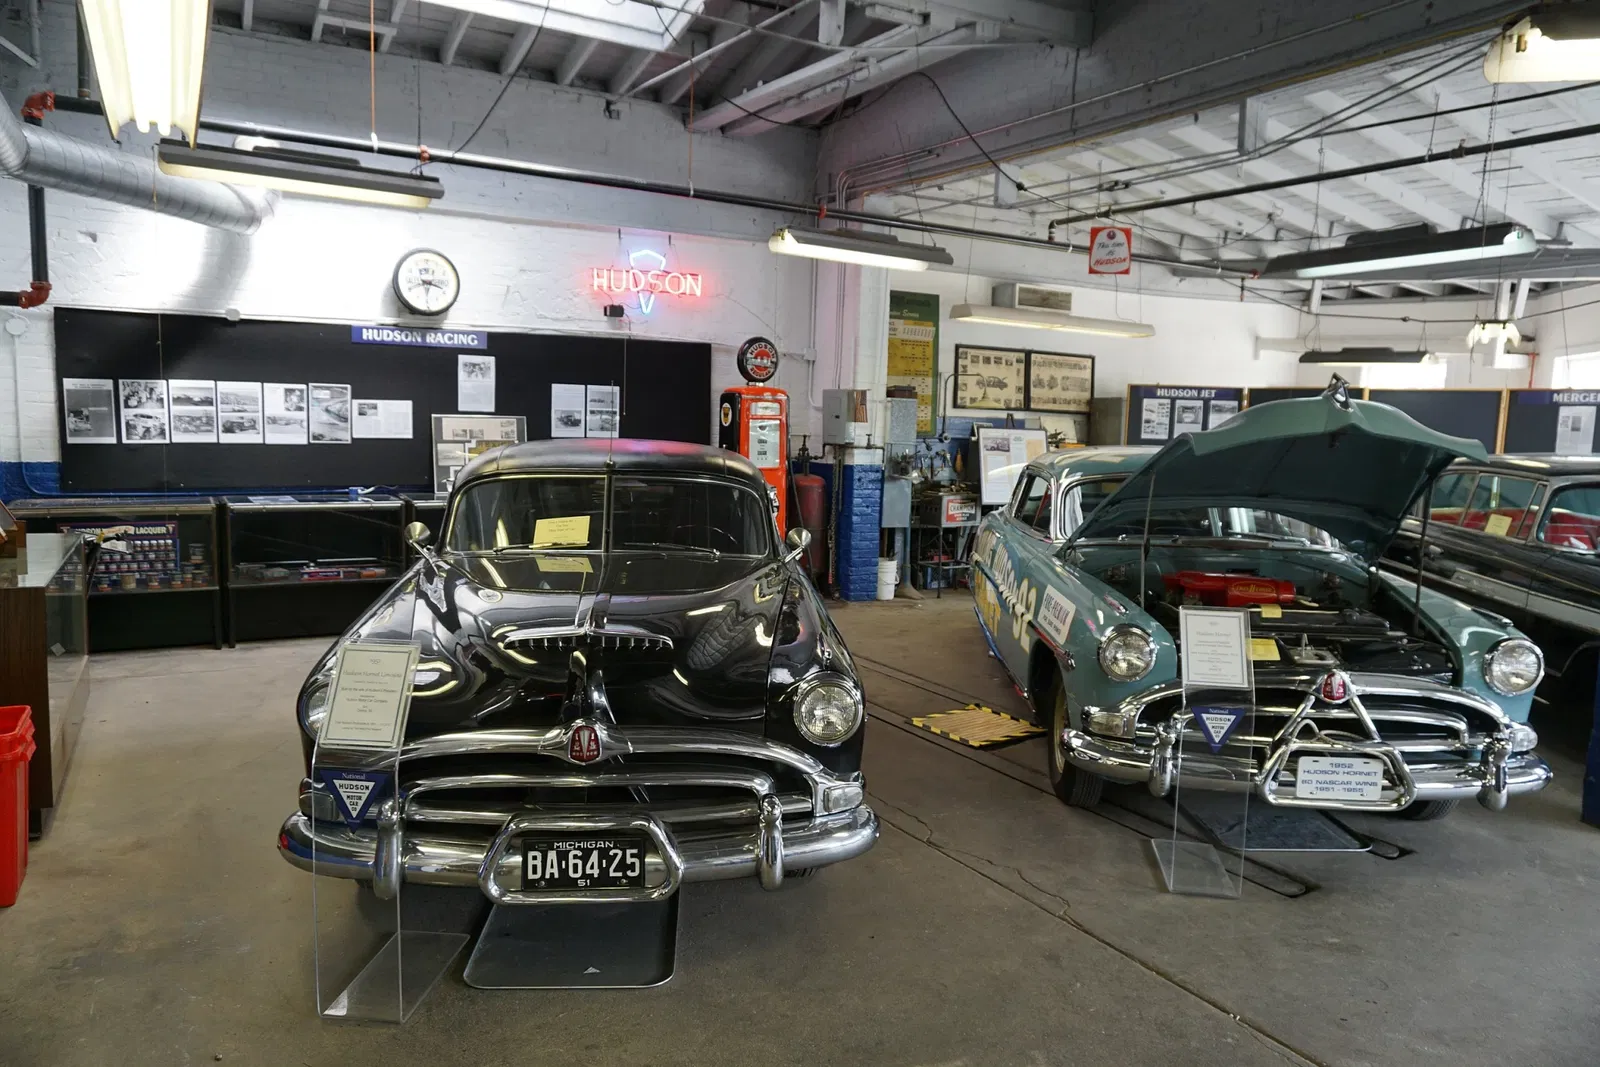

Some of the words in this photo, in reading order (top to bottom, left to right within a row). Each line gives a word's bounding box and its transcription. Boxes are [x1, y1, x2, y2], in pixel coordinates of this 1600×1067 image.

[1094, 257, 1128, 266] HUDSON
[593, 268, 702, 297] HUDSON
[362, 328, 421, 342] HUDSON
[426, 333, 478, 346] RACING
[749, 343, 776, 359] HUDSON
[1156, 388, 1198, 397] HUDSON
[1200, 390, 1216, 398] JET
[1552, 392, 1600, 403] MERGE
[135, 526, 167, 535] LACQUER
[1013, 578, 1038, 656] 92
[342, 772, 366, 780] National
[338, 783, 370, 791] HUDSON
[553, 841, 614, 849] MICHIGAN
[577, 879, 590, 887] 51
